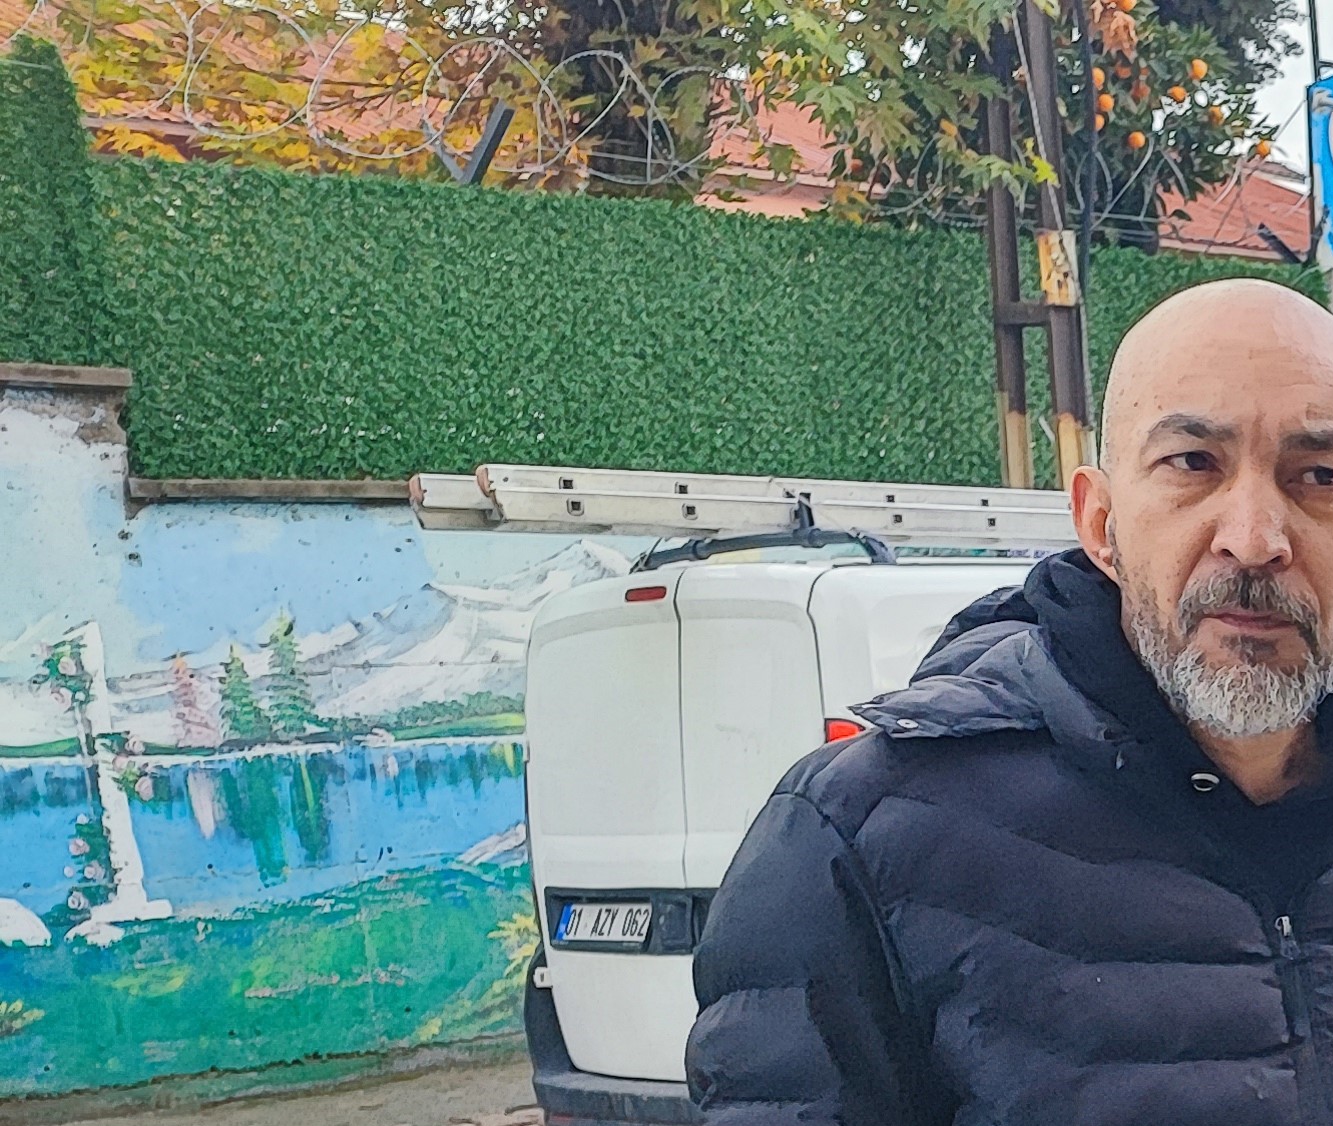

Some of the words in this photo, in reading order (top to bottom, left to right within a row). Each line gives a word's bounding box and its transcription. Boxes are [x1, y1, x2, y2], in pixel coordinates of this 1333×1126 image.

[565, 908, 584, 936] 01
[591, 908, 619, 937] AZY
[622, 908, 650, 937] 062
